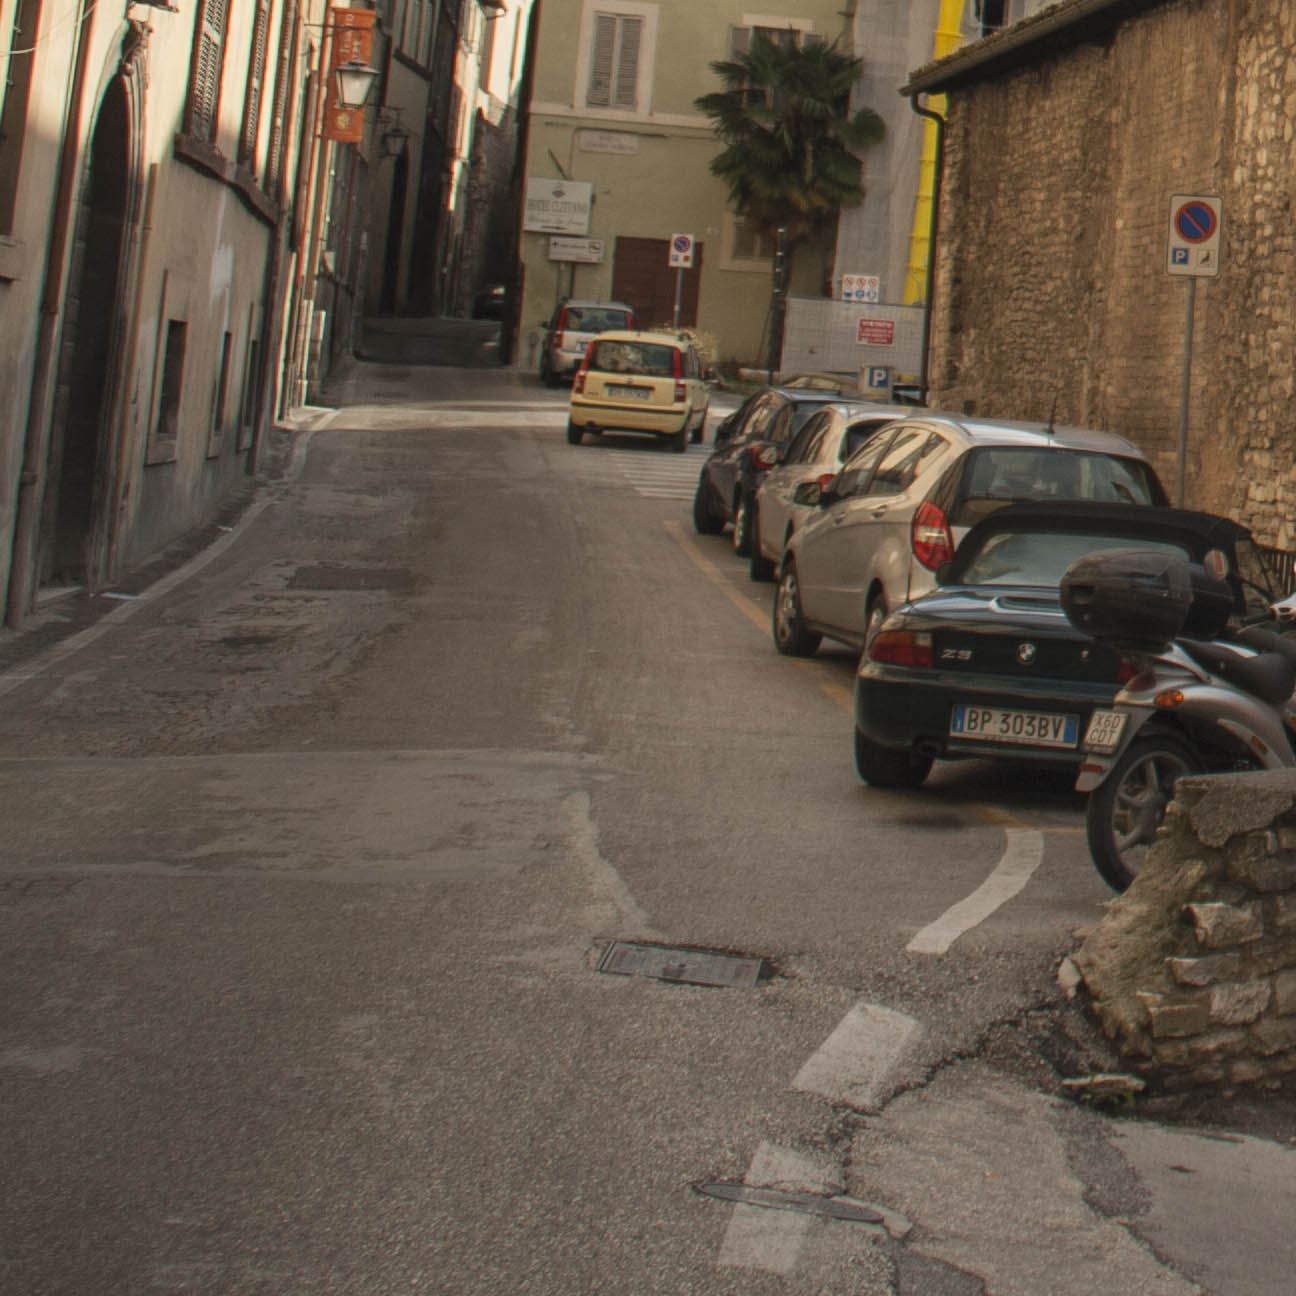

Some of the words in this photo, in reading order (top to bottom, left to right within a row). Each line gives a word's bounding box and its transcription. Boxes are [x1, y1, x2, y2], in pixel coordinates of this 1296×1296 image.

[1176, 250, 1187, 263] P
[872, 369, 887, 387] P
[967, 709, 993, 731] BP
[1000, 712, 1064, 739] 303BV
